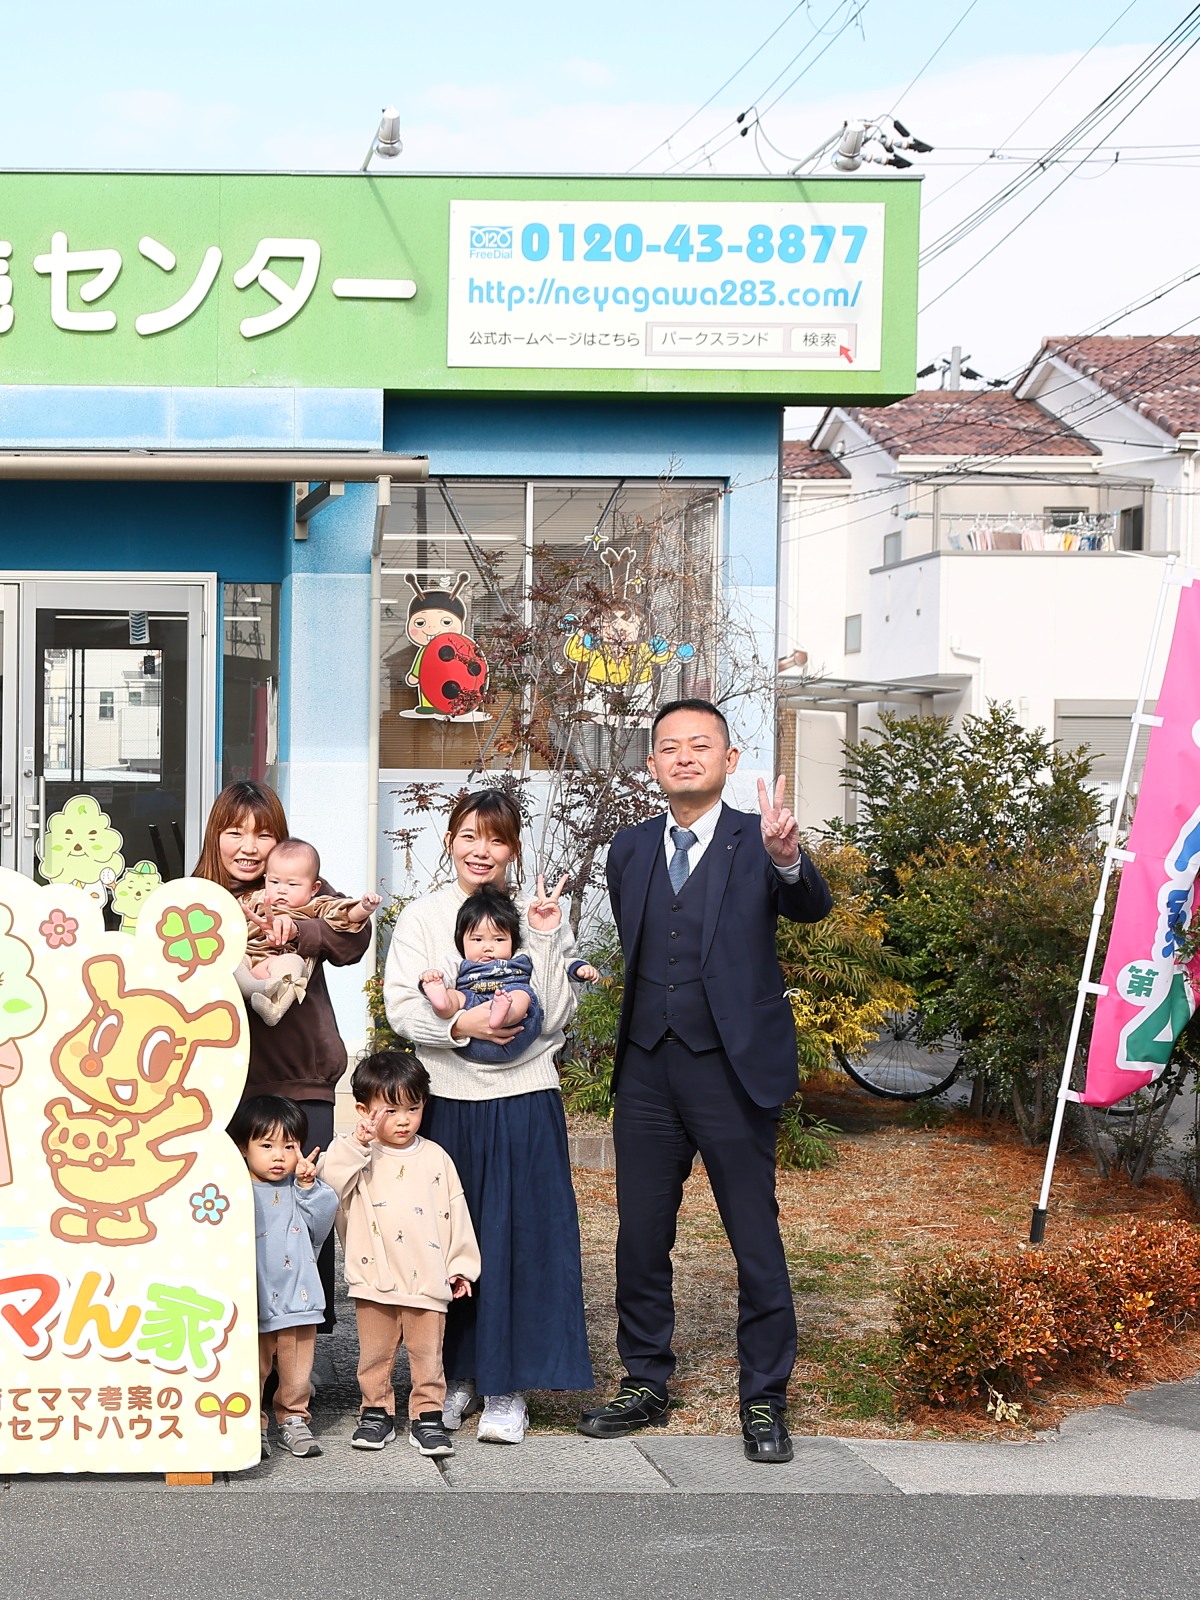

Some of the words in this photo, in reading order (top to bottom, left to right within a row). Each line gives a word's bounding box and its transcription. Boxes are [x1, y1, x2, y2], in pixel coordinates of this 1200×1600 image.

[521, 222, 868, 264] 0120-43-8877
[468, 277, 863, 312] http://neyagawa283.com/
[469, 331, 640, 347] 公式ホームページはこちら
[662, 331, 769, 347] パークスランド
[802, 331, 837, 347] 検索
